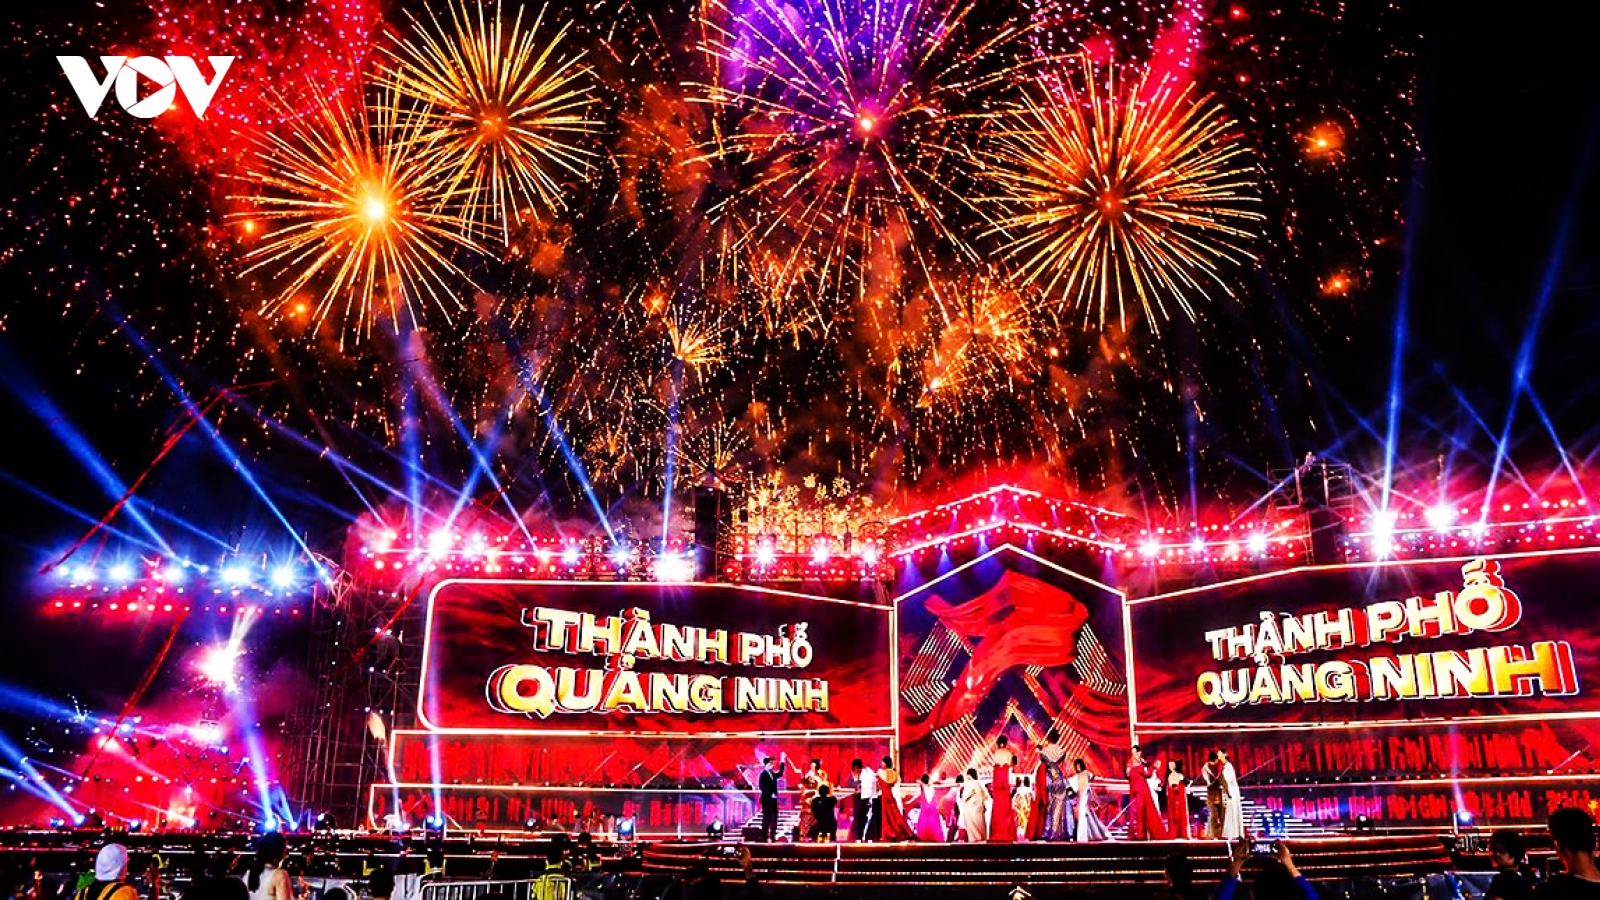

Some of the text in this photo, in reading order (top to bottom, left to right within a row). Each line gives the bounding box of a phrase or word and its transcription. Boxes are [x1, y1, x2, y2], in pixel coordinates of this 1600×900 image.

[527, 607, 813, 668] THÀNH PHỐ
[1205, 559, 1516, 660] THÀNH PHỐ
[492, 653, 829, 718] QUẢNG NINH
[1197, 641, 1573, 708] QUẢNG NINH
